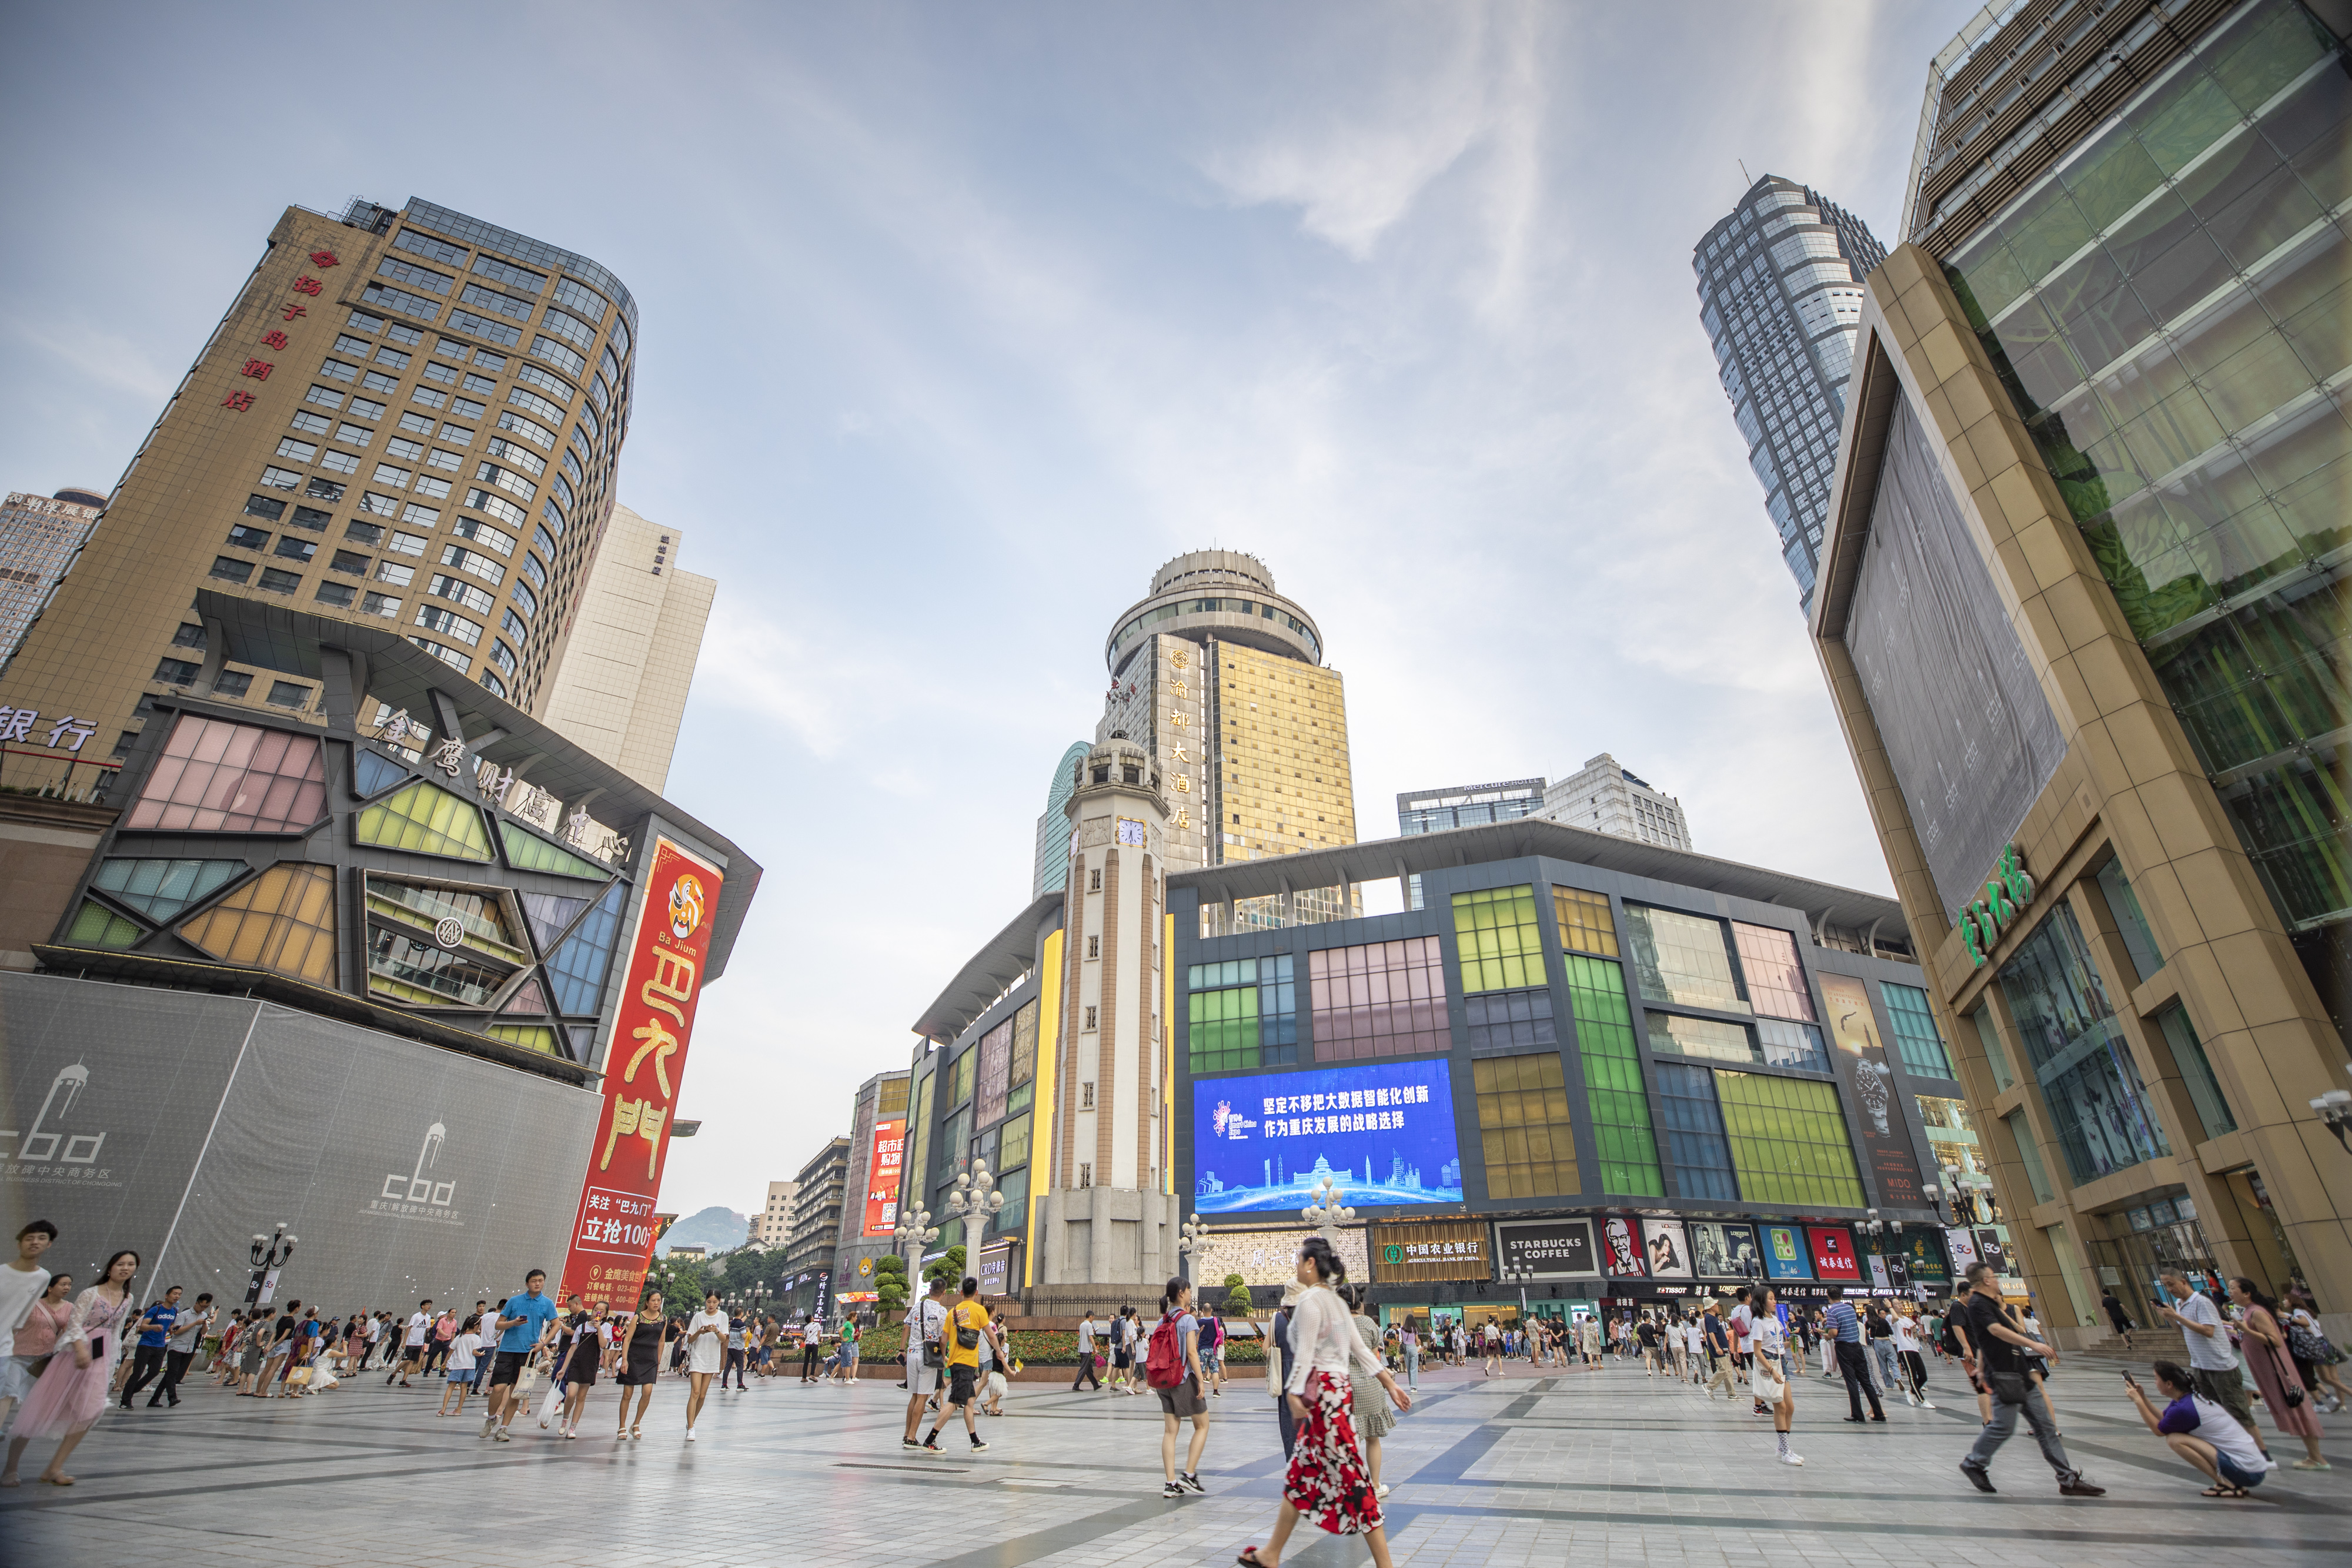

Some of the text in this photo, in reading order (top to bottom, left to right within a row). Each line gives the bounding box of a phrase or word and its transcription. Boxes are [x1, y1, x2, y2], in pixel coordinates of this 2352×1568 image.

[220, 275, 323, 412] 扬子岛酒店
[0, 708, 98, 752] 银行
[1170, 678, 1190, 830] 渝都大酒店
[378, 708, 629, 856] 金鹰财富中心
[1464, 781, 1509, 791] Mercure
[659, 931, 671, 947] Ba
[1264, 1085, 1428, 1115] 坚定不移把大数据智能化创新
[1264, 1111, 1405, 1138] 作为重庆发展的战略选择
[881, 1152, 903, 1166] 购物
[1887, 1178, 1910, 1188] MIDO
[1406, 1242, 1478, 1256] 中国农业银行
[1510, 1238, 1582, 1250] STARBUCKS
[1956, 1244, 1972, 1254] 5G
[1984, 1243, 2000, 1254] 5G
[1525, 1249, 1570, 1259] COFFEE
[1790, 1266, 1798, 1275] 4G
[1892, 1265, 1903, 1273] 5G
[250, 1281, 259, 1289] 5G
[265, 1280, 274, 1289] 5G
[1695, 1285, 1710, 1296] 瑞皇
[1616, 1298, 1633, 1306] 肯德基
